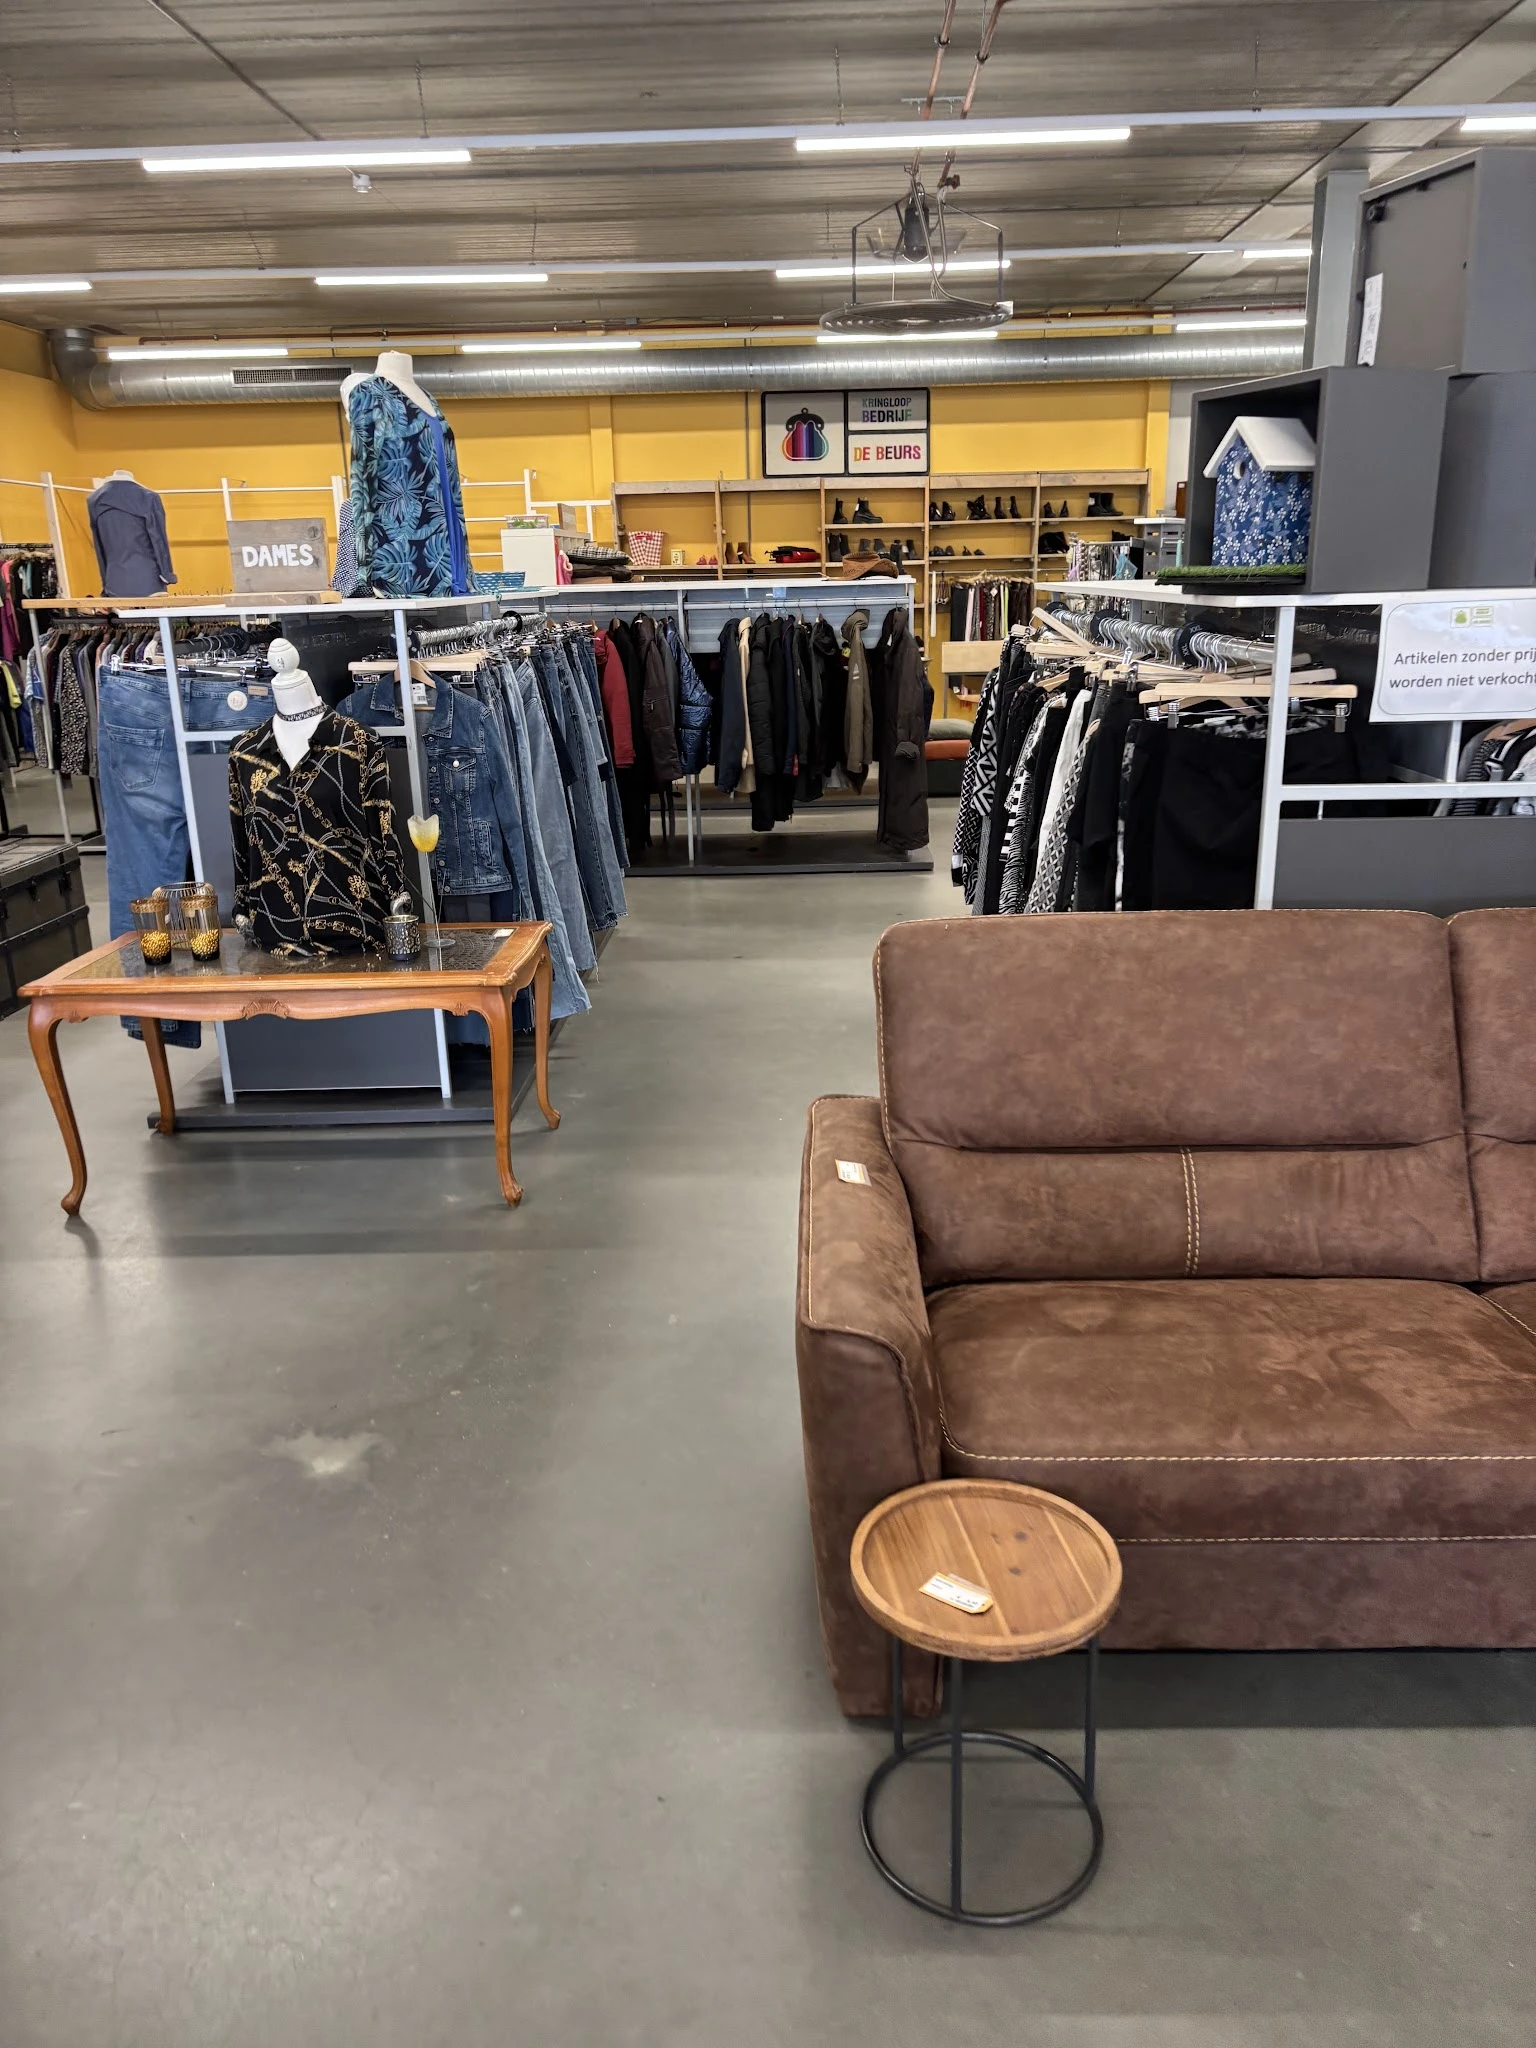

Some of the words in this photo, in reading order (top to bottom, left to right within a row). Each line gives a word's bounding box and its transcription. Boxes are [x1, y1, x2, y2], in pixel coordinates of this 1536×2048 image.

[862, 397, 912, 408] KRINGLOOP
[862, 409, 912, 423] BEDRIJF
[854, 447, 871, 461] DE
[876, 445, 922, 460] BEURS
[241, 543, 314, 568] DAMES
[1393, 650, 1457, 665] Artikelen
[1461, 648, 1511, 663] zonder
[1389, 676, 1443, 688] worden
[1447, 674, 1475, 687] niet
